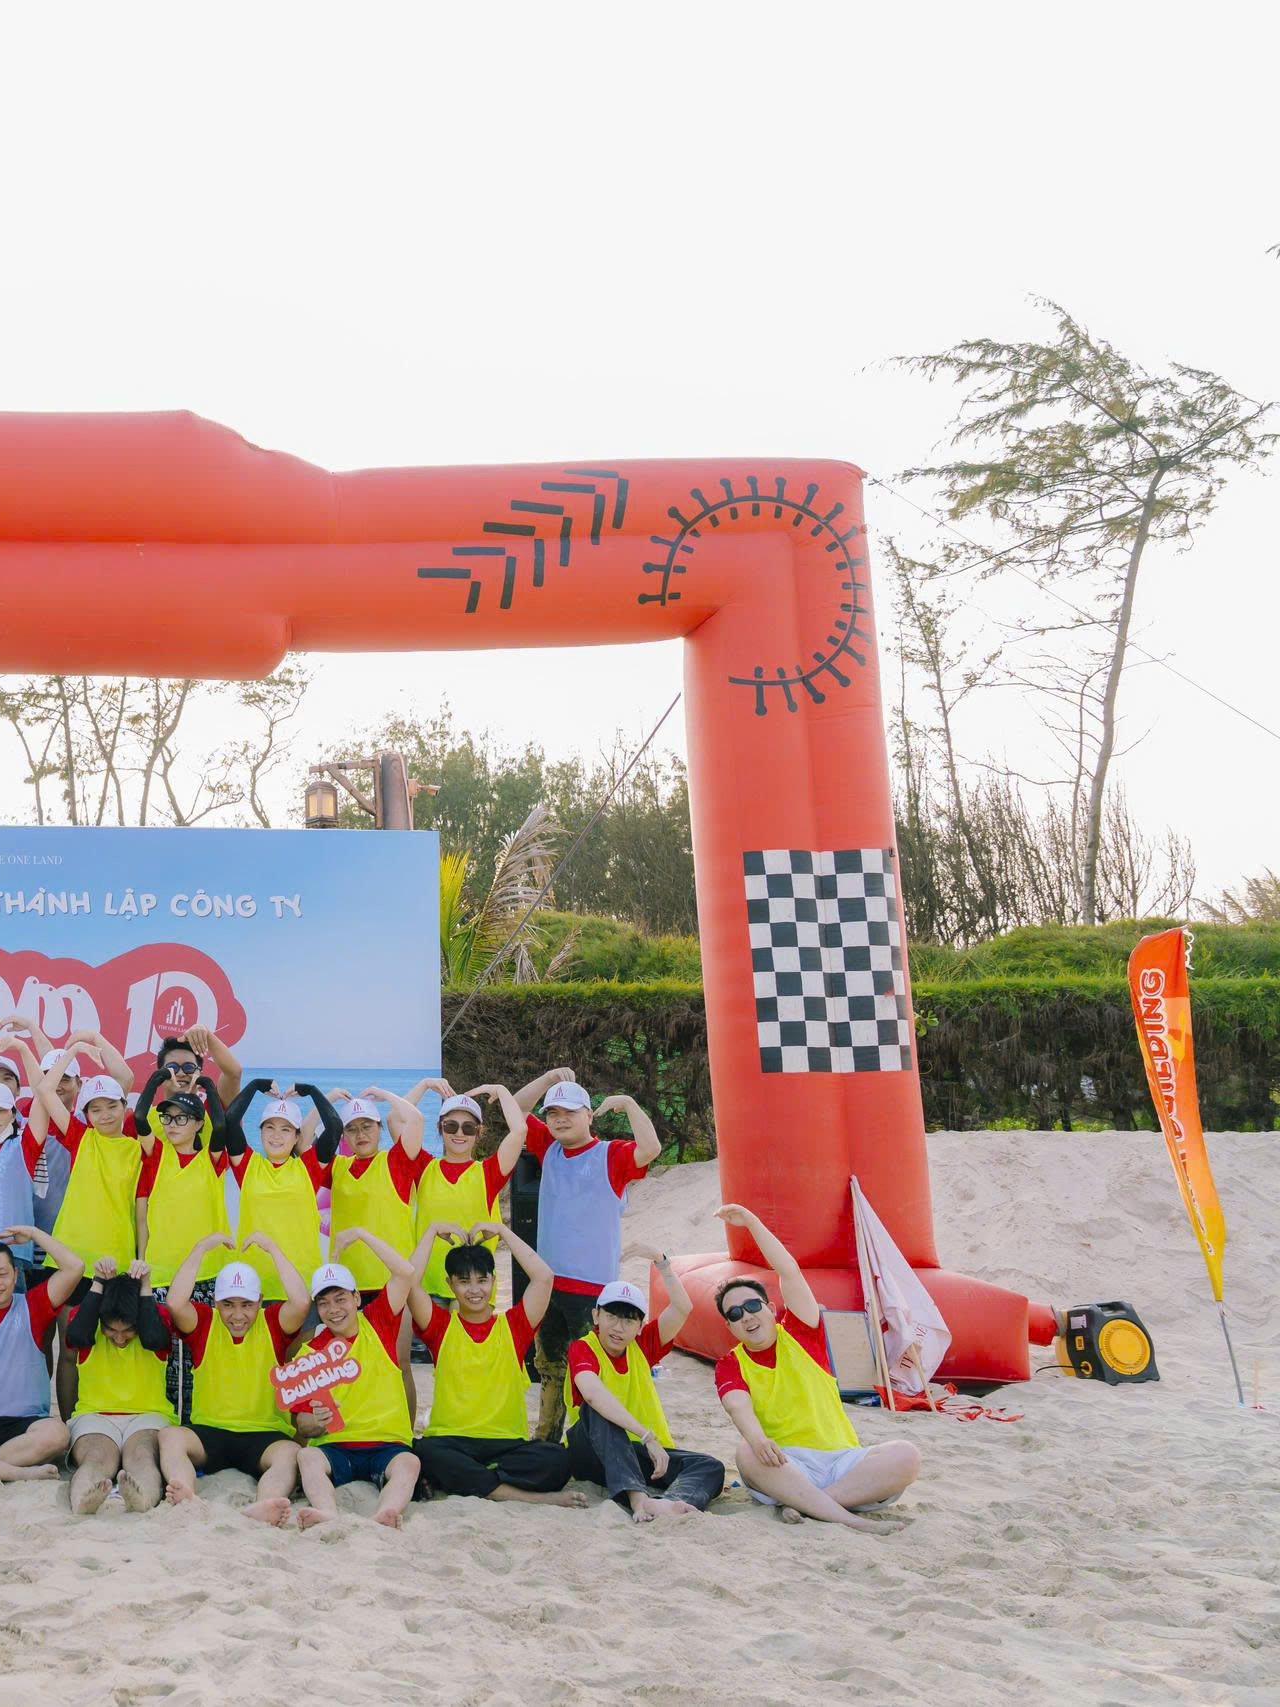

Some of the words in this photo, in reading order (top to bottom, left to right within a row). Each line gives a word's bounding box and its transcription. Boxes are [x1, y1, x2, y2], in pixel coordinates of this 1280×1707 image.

[8, 855, 31, 865] ONE
[33, 855, 64, 865] LAND
[104, 888, 157, 920] LẬP
[170, 889, 257, 918] CÔNG
[270, 894, 303, 918] TY
[275, 1352, 327, 1381] team
[281, 1359, 359, 1404] building
